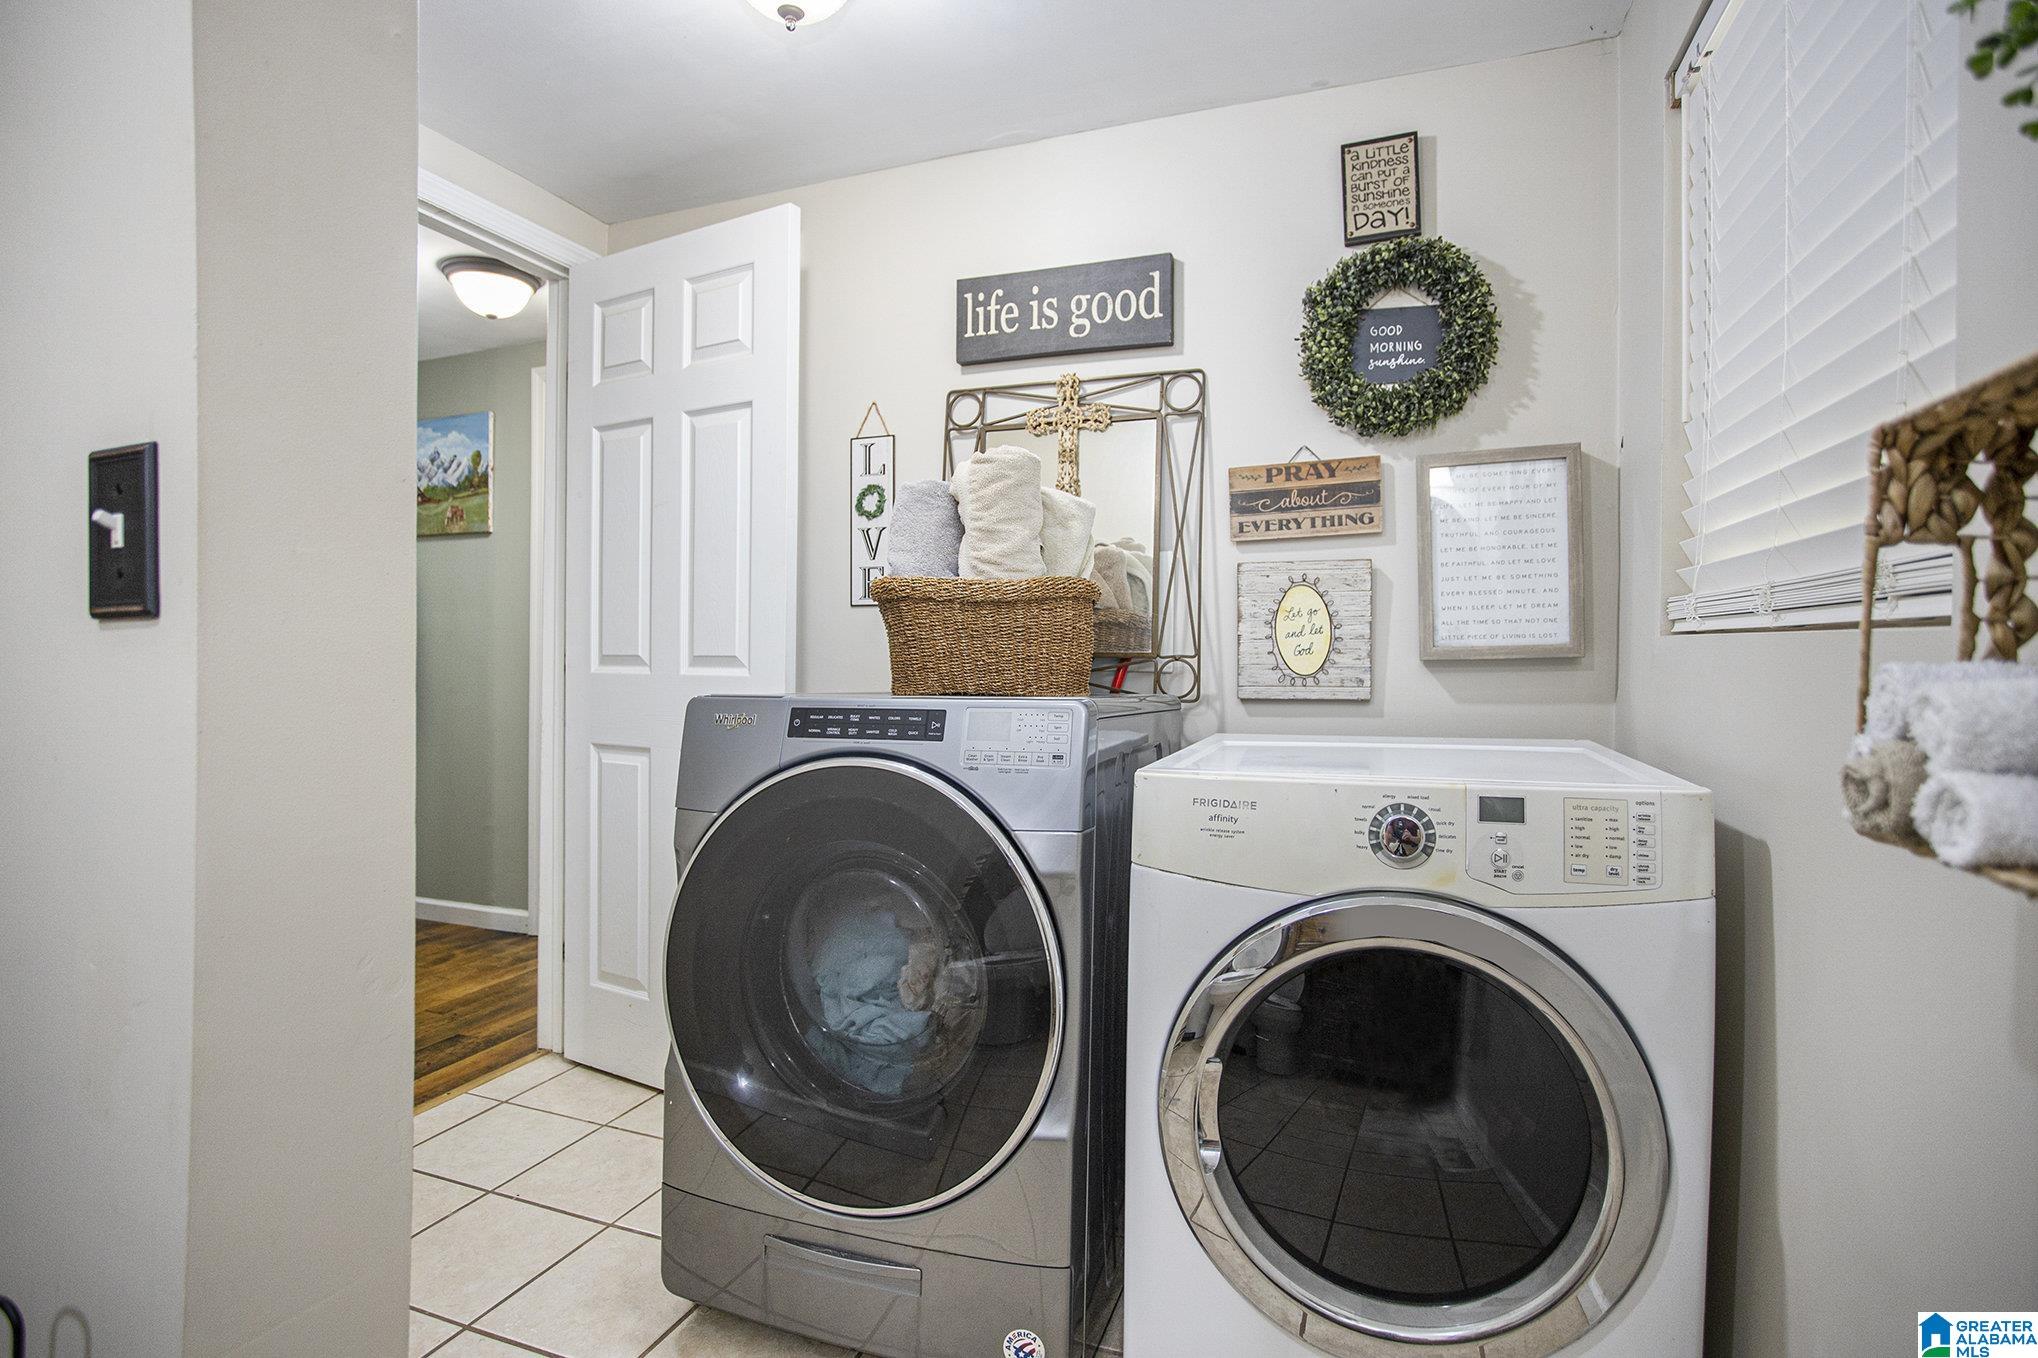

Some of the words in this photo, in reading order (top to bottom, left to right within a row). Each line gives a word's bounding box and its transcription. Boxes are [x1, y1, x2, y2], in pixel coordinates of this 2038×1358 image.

[1403, 167, 1410, 175] a
[964, 288, 1019, 337] life
[1029, 286, 1058, 330] is
[1069, 271, 1163, 338] good
[1370, 325, 1402, 337] GOOD
[1370, 340, 1422, 353] MORNING
[1266, 461, 1342, 483] PRAY
[1281, 490, 1329, 508] about
[1239, 512, 1375, 533] EVERYTHING
[1510, 572, 1558, 580] SOMETHING
[1284, 607, 1303, 621] Let
[1307, 608, 1320, 622] go
[1285, 625, 1306, 638] and
[1309, 624, 1323, 634] let
[1294, 642, 1314, 656] God
[714, 712, 757, 727] Whirlpool
[1193, 798, 1257, 810] FRIGIDAIRE
[1208, 813, 1239, 825] affinity
[1006, 1332, 1037, 1351] AMERICA
